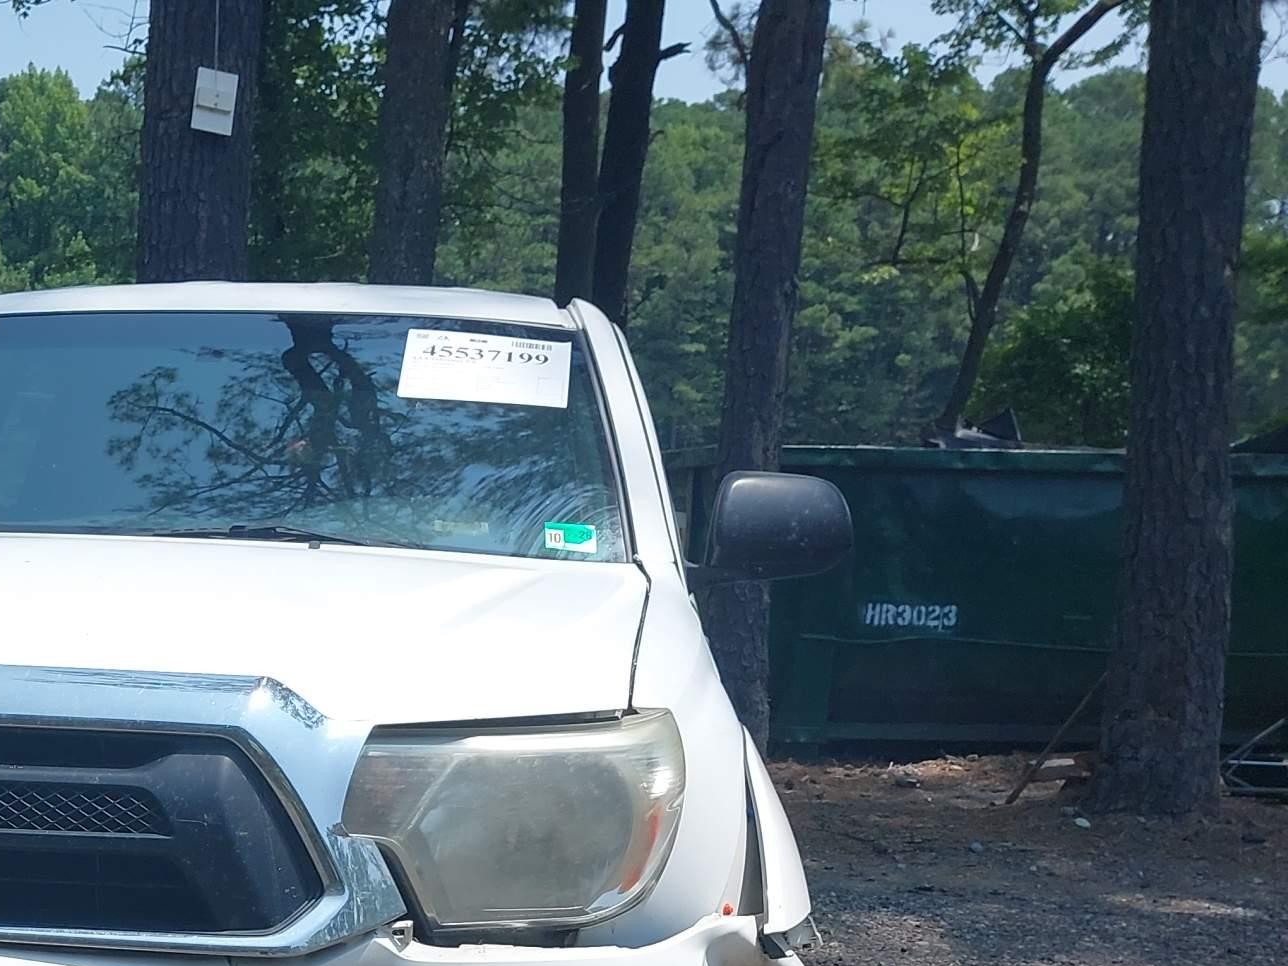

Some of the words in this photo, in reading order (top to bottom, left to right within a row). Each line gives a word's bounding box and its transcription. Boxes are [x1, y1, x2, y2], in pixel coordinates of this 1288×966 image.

[422, 343, 550, 366] 45537199
[548, 532, 562, 544] 10
[864, 602, 958, 627] HR3023
